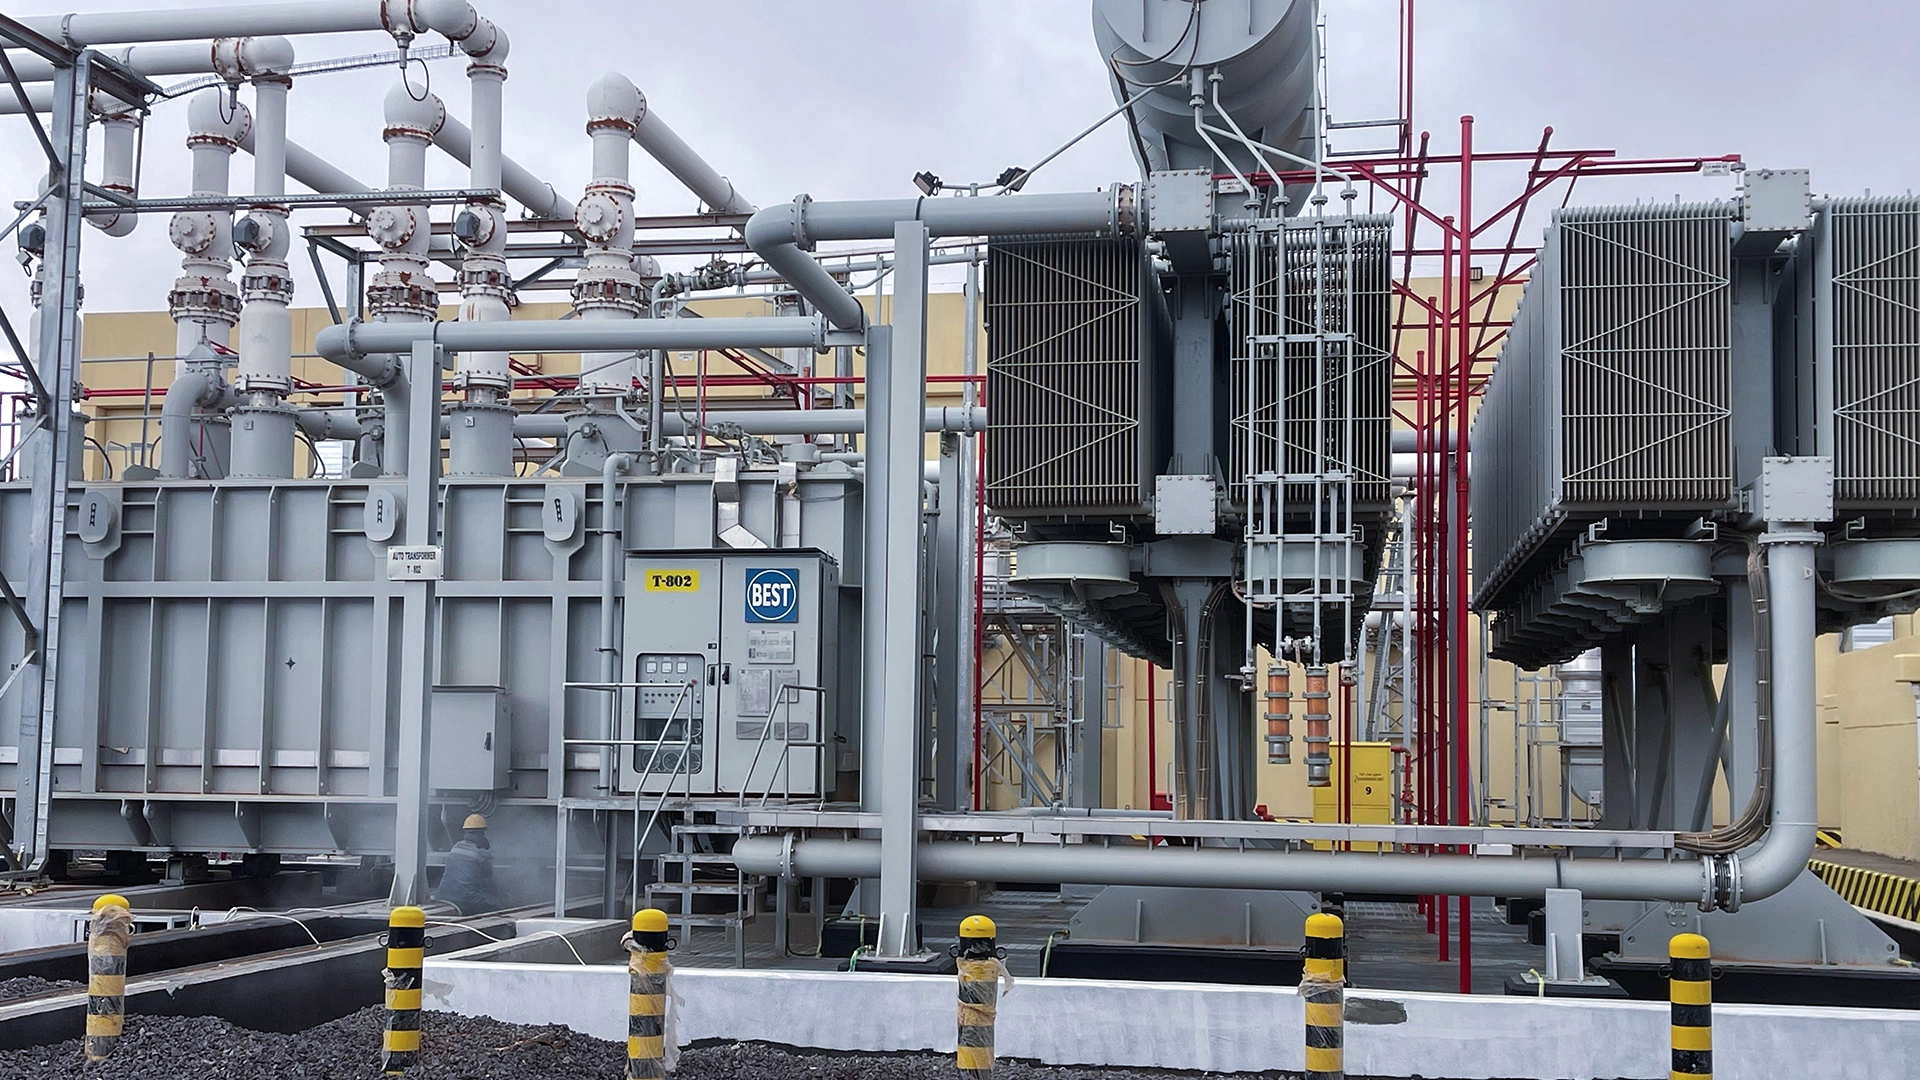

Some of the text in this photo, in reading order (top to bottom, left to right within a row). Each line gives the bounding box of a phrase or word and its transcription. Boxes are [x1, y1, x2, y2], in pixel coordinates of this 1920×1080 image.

[392, 552, 436, 560] AUTO TRANSFORMER
[652, 575, 692, 587] T-802
[752, 583, 791, 607] BEST
[1365, 786, 1372, 795] 9
